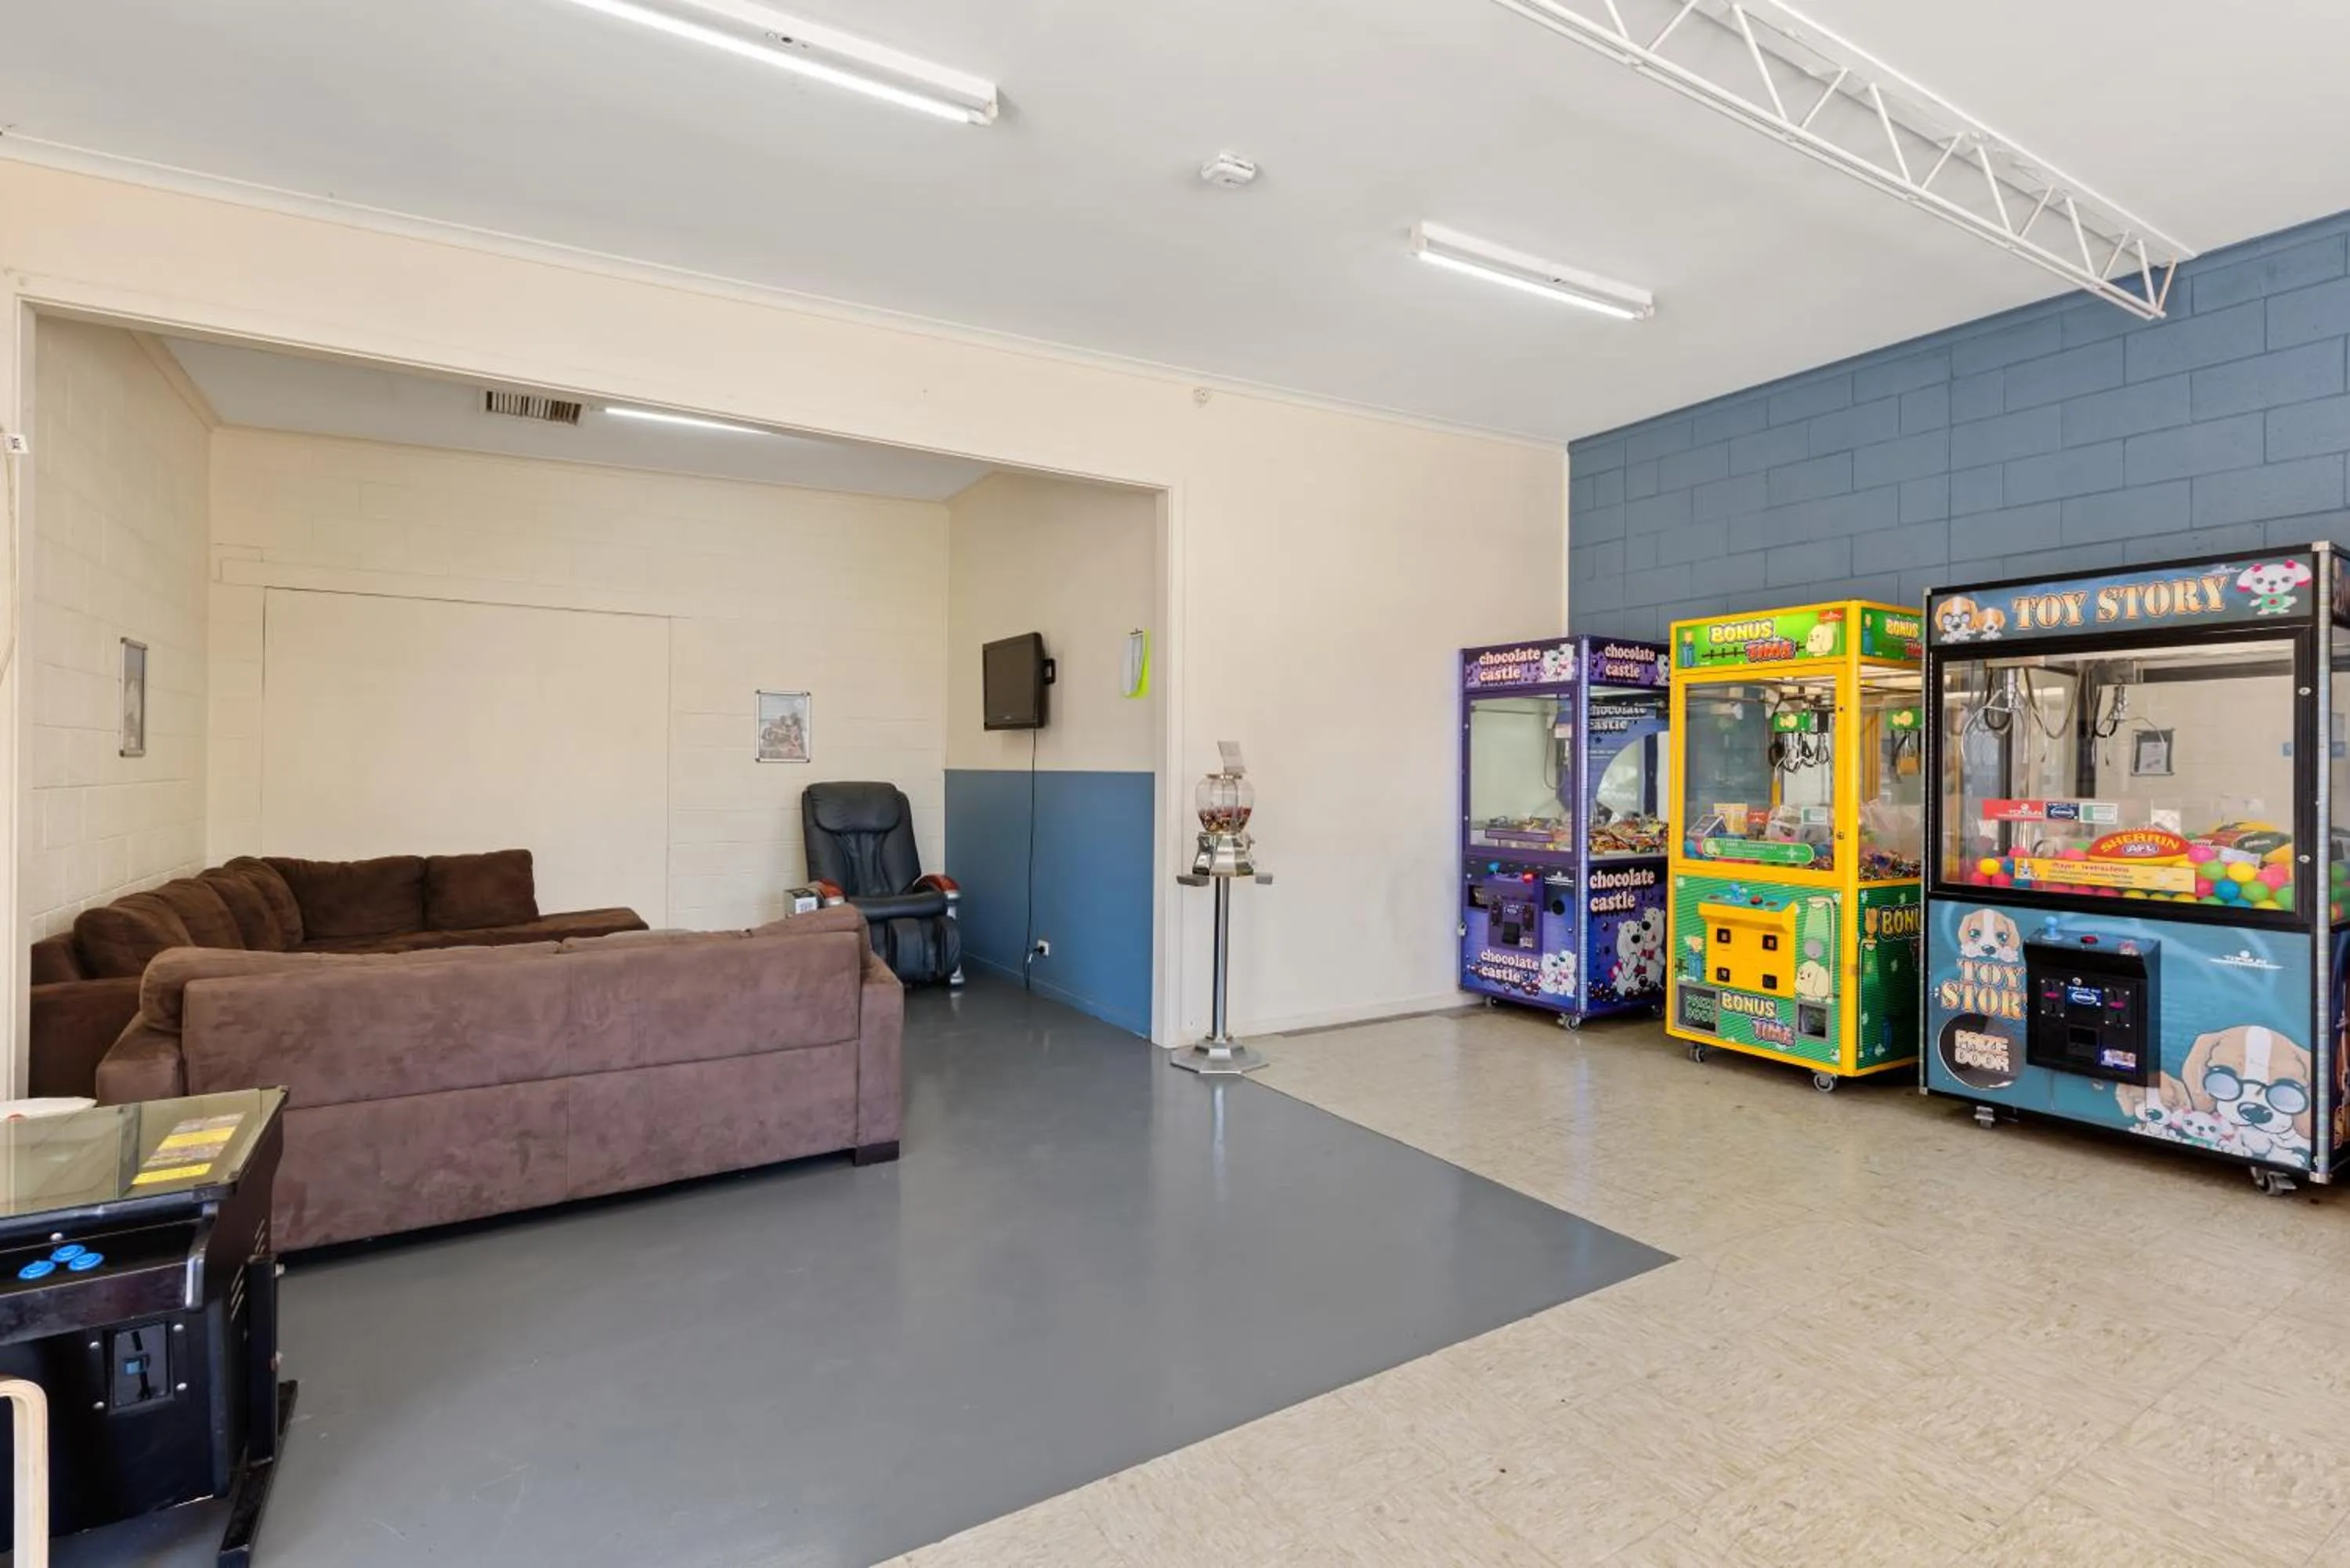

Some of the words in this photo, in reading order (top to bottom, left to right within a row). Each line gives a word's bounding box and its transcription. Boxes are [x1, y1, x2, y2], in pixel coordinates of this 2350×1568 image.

[2012, 591, 2087, 630] TOY
[2096, 575, 2229, 623] STORY
[1709, 619, 1774, 644] BONUS
[1885, 617, 1919, 638] BONUS
[1478, 648, 1541, 666] chocolate
[1604, 643, 1655, 662] chocolate
[1479, 667, 1521, 681] castle
[1605, 663, 1640, 677] castle
[2100, 833, 2180, 853] SHERRIN
[1589, 867, 1655, 889] chocolate
[1590, 891, 1636, 912] castle
[1880, 907, 1922, 936] BONU
[1480, 948, 1539, 970] chocolate
[1481, 966, 1521, 984] castle
[1957, 958, 2026, 990] TOY
[1721, 991, 1777, 1018] BONUS
[1940, 979, 2028, 1021] STOR
[1752, 1019, 1796, 1046] TIME
[1954, 1029, 2009, 1053] PRIZE
[1954, 1048, 2010, 1072] DOOR
